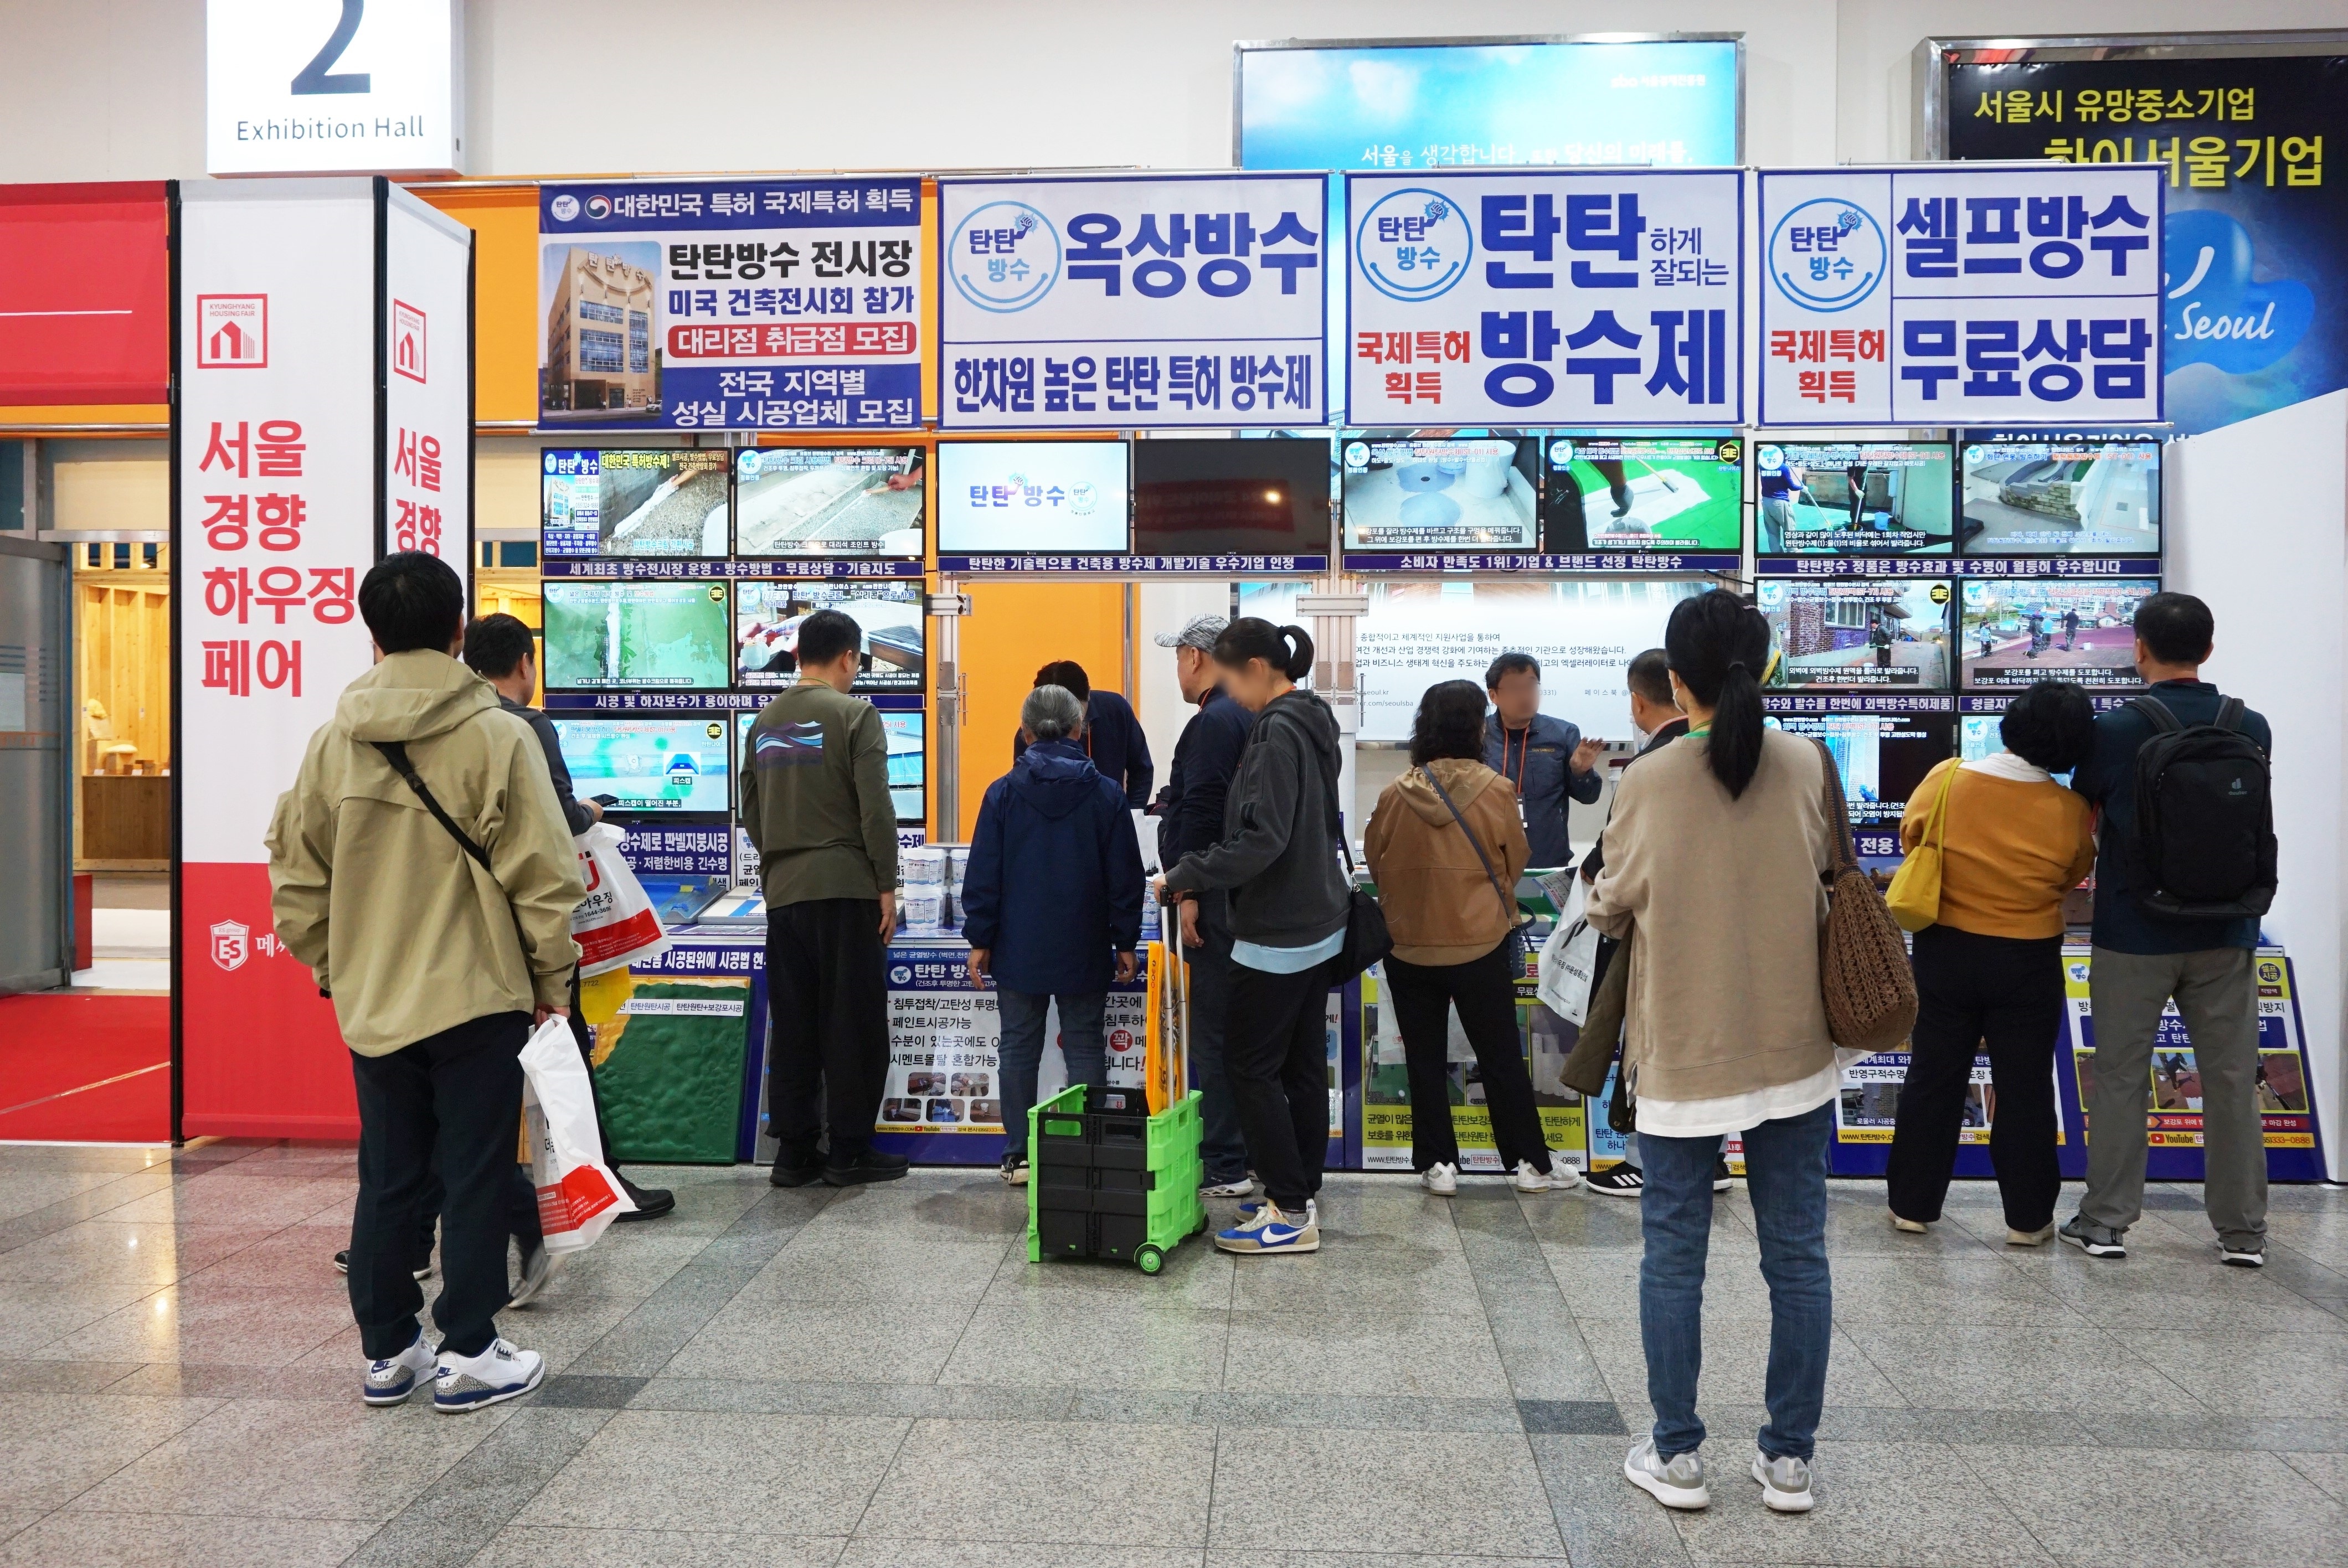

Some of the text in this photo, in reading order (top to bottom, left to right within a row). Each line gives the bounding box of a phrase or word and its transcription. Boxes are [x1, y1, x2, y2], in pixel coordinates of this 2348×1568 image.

[291, 0, 370, 95] 2
[1974, 88, 2254, 123] 서울시 유망중소기업
[238, 116, 424, 140] Exhibition Hall
[614, 188, 913, 218] 대한민국 특허 국제특허 획득
[1378, 216, 1426, 241] 탄탄
[1481, 193, 1646, 288] 탄탄
[1650, 228, 1701, 254] 하게
[1790, 226, 1840, 252] 탄탄
[1897, 195, 2150, 278] 셀프방수
[970, 229, 1017, 254] 탄탄
[670, 240, 912, 280] 탄탄방수 전시장
[1066, 213, 1319, 297] 옥상방수
[1397, 246, 1440, 270] 방수
[988, 259, 1030, 282] 방수
[1650, 259, 1729, 286] 잘되는
[1810, 257, 1855, 281] 방수
[670, 286, 914, 316] 미국 건축전시회 참가
[2174, 302, 2275, 341] Seoul
[678, 324, 908, 355] 대리점 취급점 모집
[1358, 331, 1470, 364] 국제특허
[1771, 329, 1884, 363] 국제특허
[1481, 310, 1726, 407] 방수제
[1901, 319, 2153, 401] 무료상담
[719, 370, 865, 397] 전국 지역별
[955, 354, 1311, 412] 한차원 높은 탄탄 특허 방수제
[1385, 372, 1442, 404] 획득
[1799, 370, 1855, 403] 획득
[672, 399, 913, 426] 성실 시공업체 모집
[199, 420, 306, 478] 서울
[394, 427, 442, 492] 서울
[559, 459, 598, 473] 탄탄 방수
[970, 486, 1064, 507] 탄탄 방수
[202, 493, 306, 551] 경향
[569, 563, 895, 576] 세계최초 방수전시장 운영 방수방법 무료상담 기술지도
[969, 556, 1295, 570] 탄탄한 기술력으로 건축용 방수제 개발기술 우수기업 인정
[1401, 555, 1682, 569] 소비자 만족도 1위! 기업 & 브랜드 선정 탄탄방수
[1797, 560, 2121, 572] 탄탄방수 정품은 방수효과 및 수명이 월등히 우수합니다
[203, 567, 355, 625] 하우징
[1361, 633, 1500, 642] 종합적이고 체계적인 지원사업을 통하여
[1373, 646, 1396, 655] 개선과
[1417, 646, 1439, 655] 경쟁력
[1442, 646, 1465, 655] 강화에
[1468, 646, 1499, 655] 기여하는
[202, 640, 301, 697] 페어
[596, 695, 753, 708] 시공 및 하자보수가 용이하며
[1795, 698, 1951, 711] 발수를 한번에 외벽방수특허제품
[666, 832, 728, 852] 판넬지붕시공
[643, 856, 728, 871] 저렴한비용 긴수명
[665, 951, 750, 969] 시공된위에 시공법
[915, 964, 946, 978] 탄탄
[631, 1003, 671, 1011] 탄탄원탄시공
[893, 1017, 971, 1029] 페인트시공가능
[892, 1035, 924, 1047] 수분이
[1113, 1033, 1130, 1048] 꽉
[890, 1054, 947, 1066] 시멘트몰탈
[1367, 1115, 1580, 1127] 균열이 탄탄하게
[1367, 1131, 1394, 1141] 보호를
[2165, 1135, 2193, 1144] YouTube
